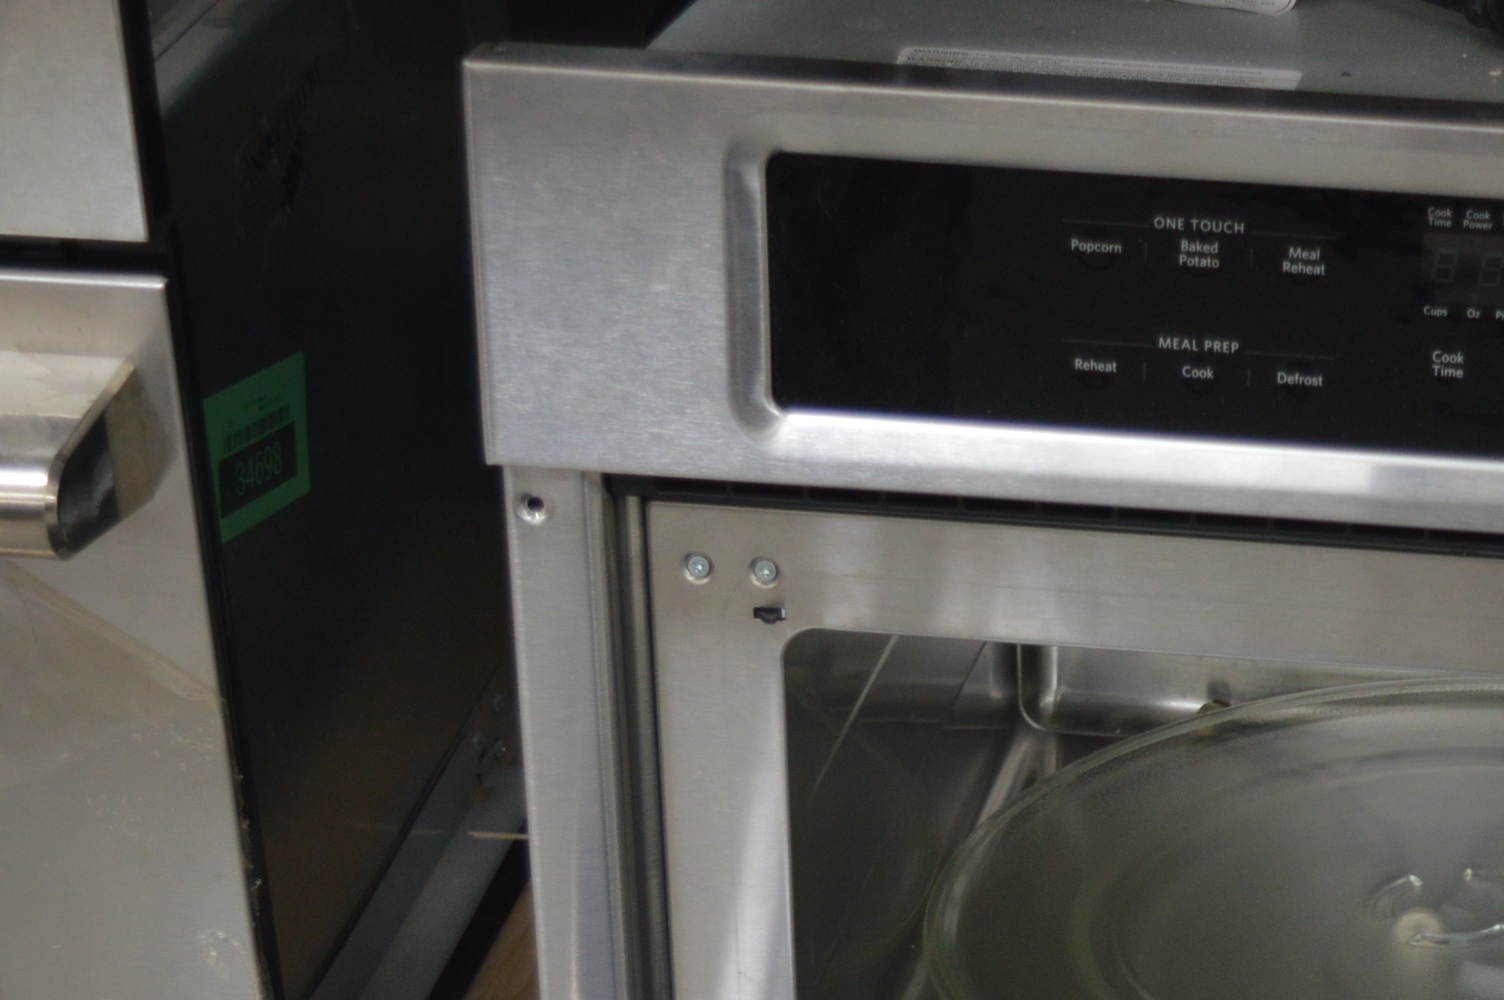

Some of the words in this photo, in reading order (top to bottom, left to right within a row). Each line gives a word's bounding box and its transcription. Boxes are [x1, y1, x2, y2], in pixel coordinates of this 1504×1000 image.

[1427, 207, 1453, 218] Cook
[1466, 209, 1490, 221] Cook
[1153, 217, 1185, 231] ONE
[1191, 219, 1244, 234] TOUCH
[1428, 218, 1452, 228] Time
[1463, 219, 1493, 230] Power
[1071, 239, 1122, 254] Popcorn
[1180, 240, 1219, 254] Baked
[1288, 247, 1321, 261] Meal
[1179, 254, 1220, 269] Potato
[1282, 261, 1326, 276] Reheat
[1423, 305, 1448, 317] Cups
[1466, 308, 1480, 319] Oz
[1158, 337, 1199, 352] MEAL
[1204, 340, 1239, 354] PREP
[1432, 350, 1464, 365] Cook
[1074, 358, 1117, 373] Reheat
[1182, 365, 1214, 379] Cook
[1432, 364, 1464, 379] Time
[1277, 372, 1323, 387] Defrost
[236, 441, 282, 497] 34698
